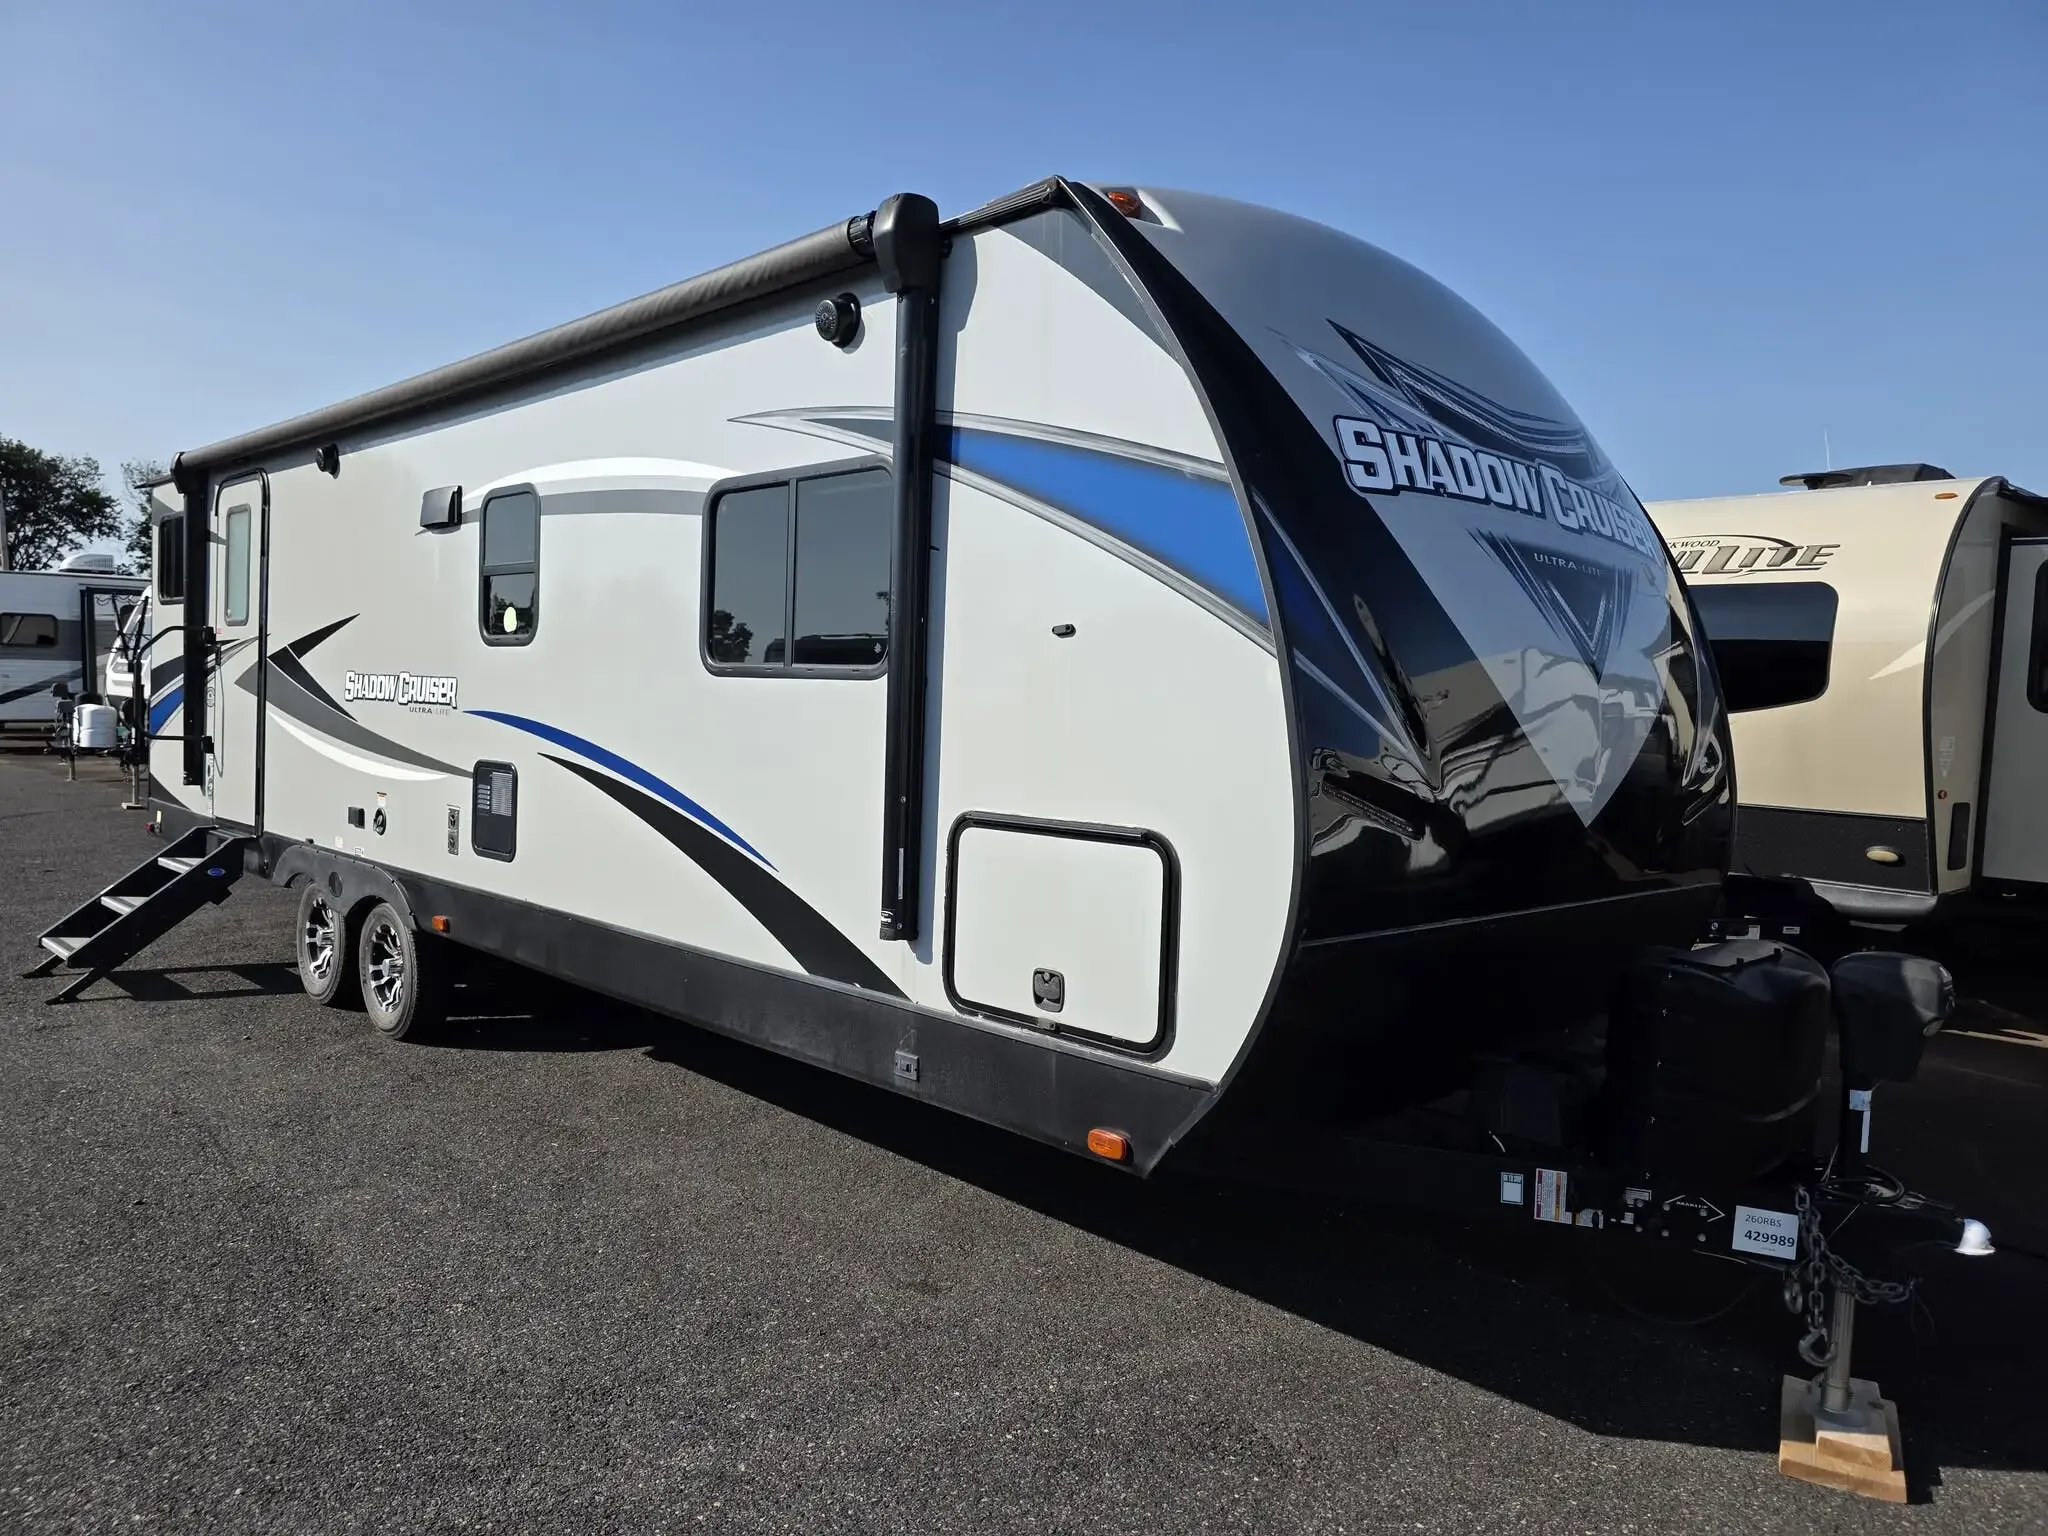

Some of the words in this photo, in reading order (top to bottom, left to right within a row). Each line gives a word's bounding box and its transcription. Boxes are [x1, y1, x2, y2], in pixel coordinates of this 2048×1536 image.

[1333, 414, 1547, 519] SHADOW
[1539, 460, 1663, 569] CRUISER
[1668, 539, 1721, 549] KWOOD
[1533, 552, 1577, 570] ULTRA
[344, 670, 400, 702] SHADOW
[398, 671, 458, 709] CRUISER
[409, 706, 433, 714] ULTRA
[1744, 1214, 1782, 1228] 260RBS
[1744, 1229, 1796, 1248] 429989
